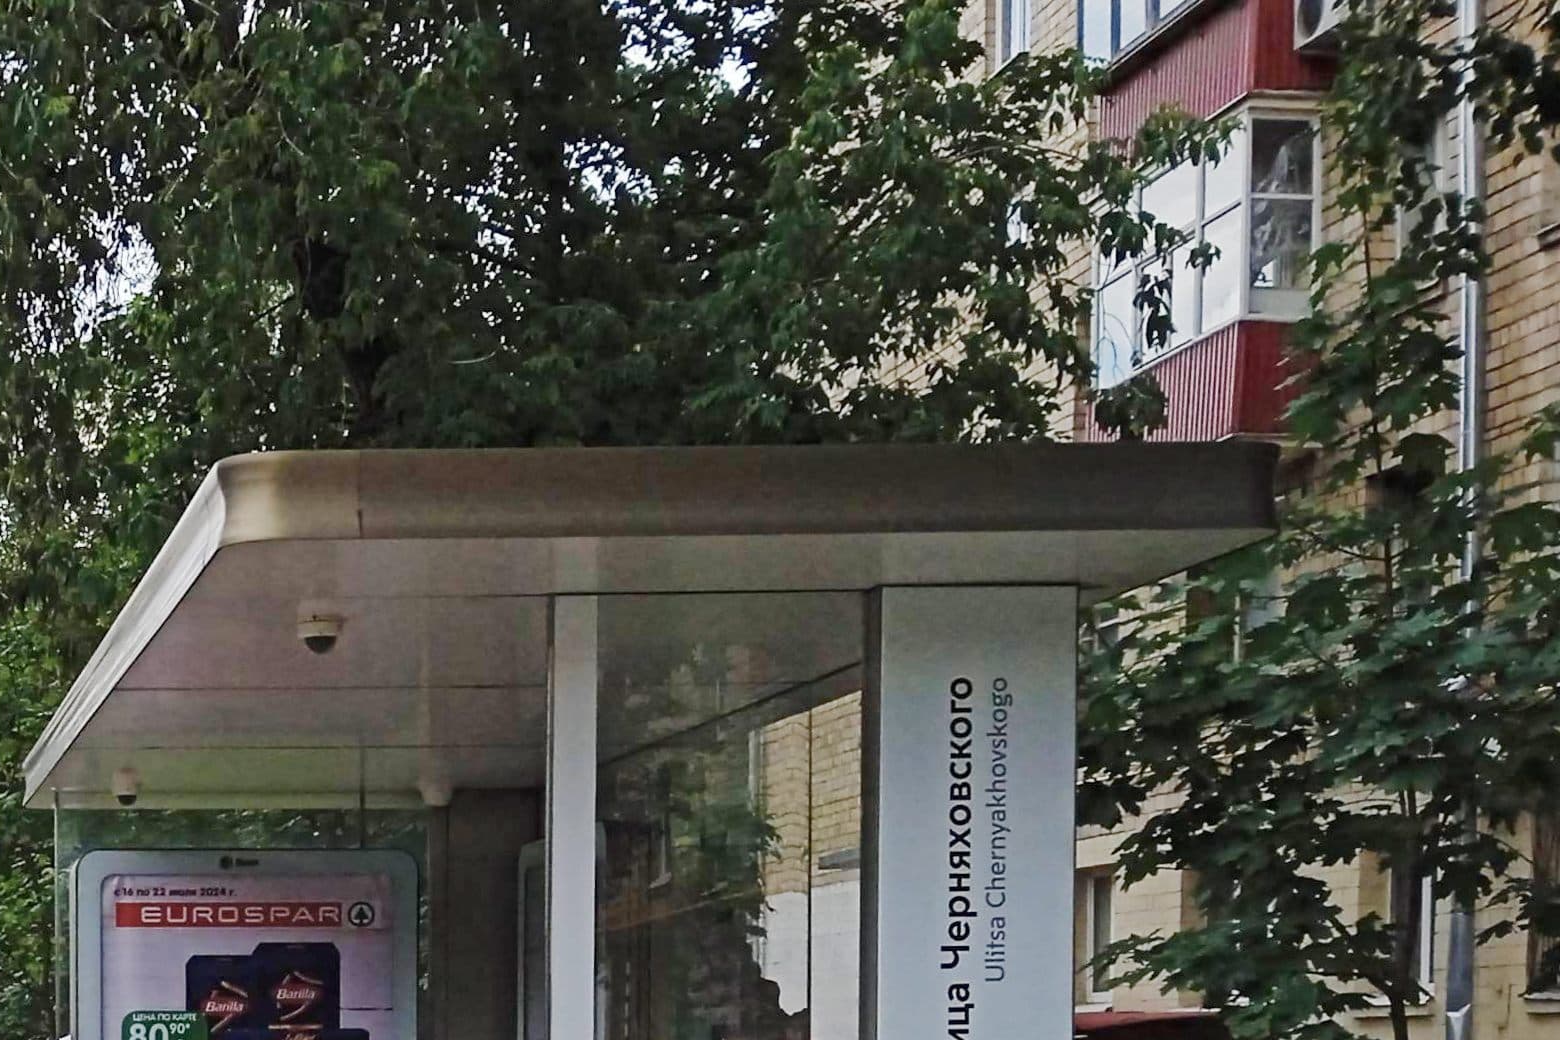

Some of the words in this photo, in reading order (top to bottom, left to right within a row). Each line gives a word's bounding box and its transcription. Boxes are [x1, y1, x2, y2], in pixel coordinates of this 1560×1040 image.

[985, 677, 1013, 908] Chernyakhovskogo
[940, 676, 977, 969] Черняховского
[122, 887, 133, 897] 16
[136, 889, 150, 897] по
[153, 887, 166, 897] 22
[140, 906, 340, 924] EUROSPAR
[985, 915, 1006, 982] Ulitsa
[276, 988, 316, 1000] Barilla
[205, 1001, 245, 1013] Barilla
[132, 1013, 157, 1021] ЦЕНА
[157, 1013, 171, 1021] ПО
[172, 1013, 197, 1021] КАРТЕ
